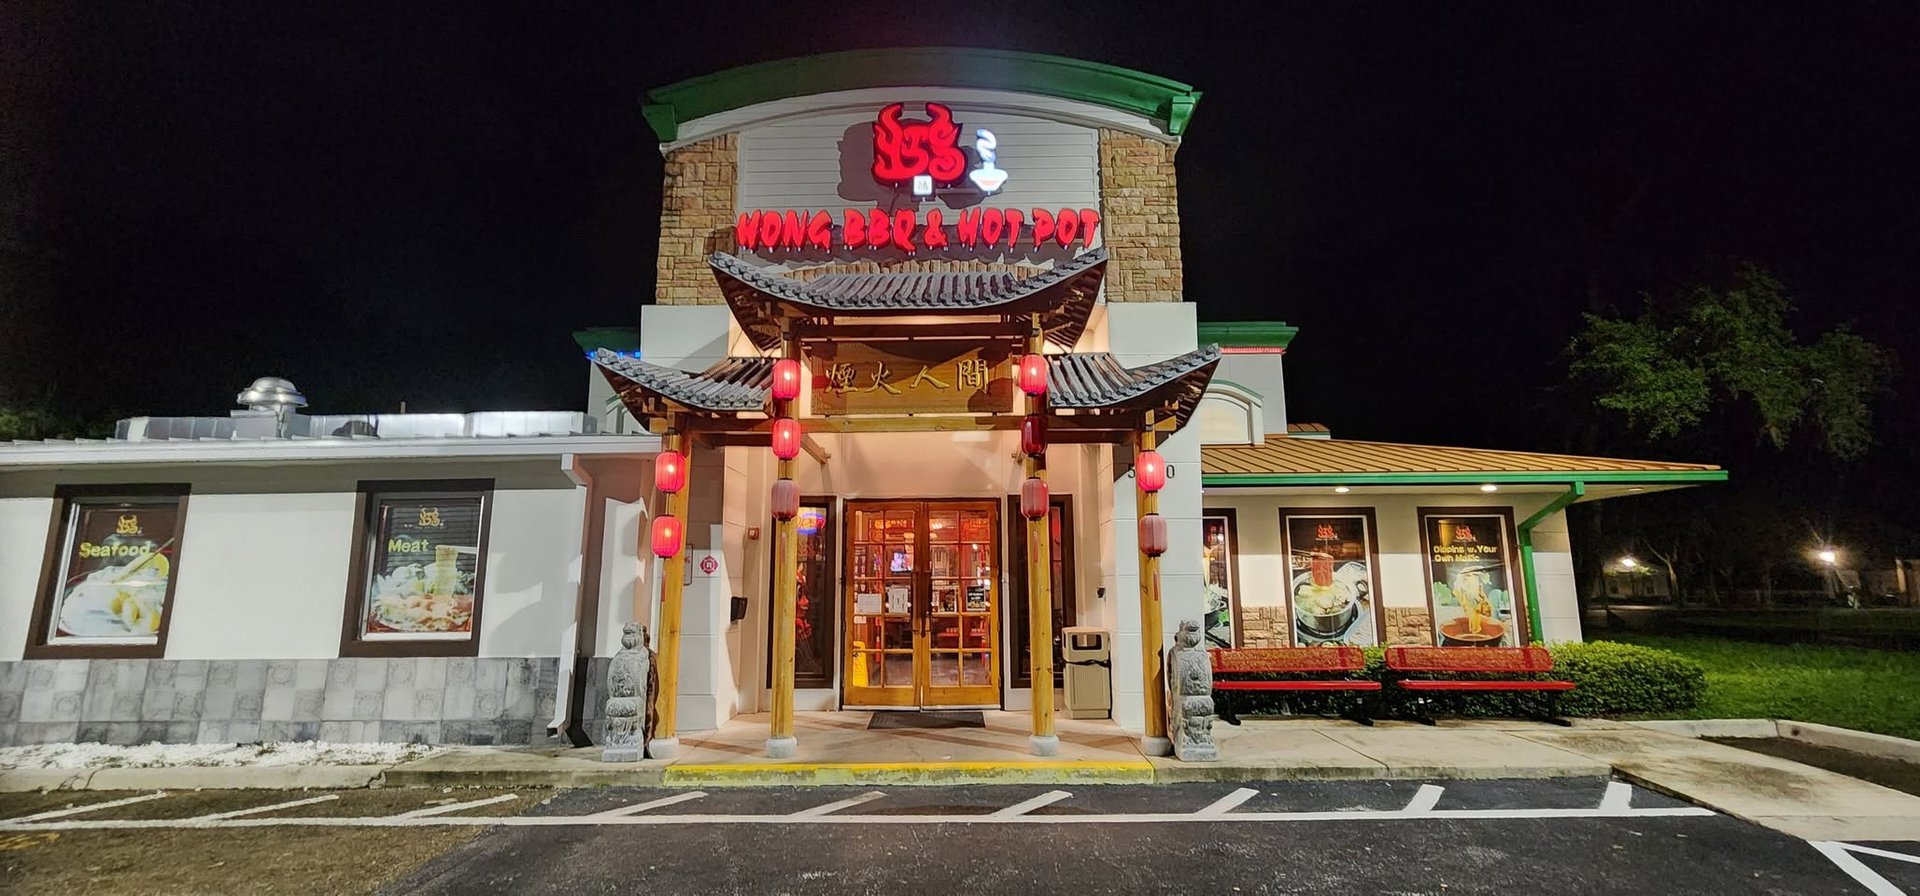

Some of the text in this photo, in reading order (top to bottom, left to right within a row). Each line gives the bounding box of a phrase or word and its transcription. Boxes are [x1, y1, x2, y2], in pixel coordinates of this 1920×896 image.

[736, 207, 1099, 251] HONG BBQ & HOT POT
[823, 359, 989, 395] 煙火人間
[79, 541, 151, 558] Seafood
[388, 539, 430, 553] Meat
[1434, 554, 1454, 562] Own
